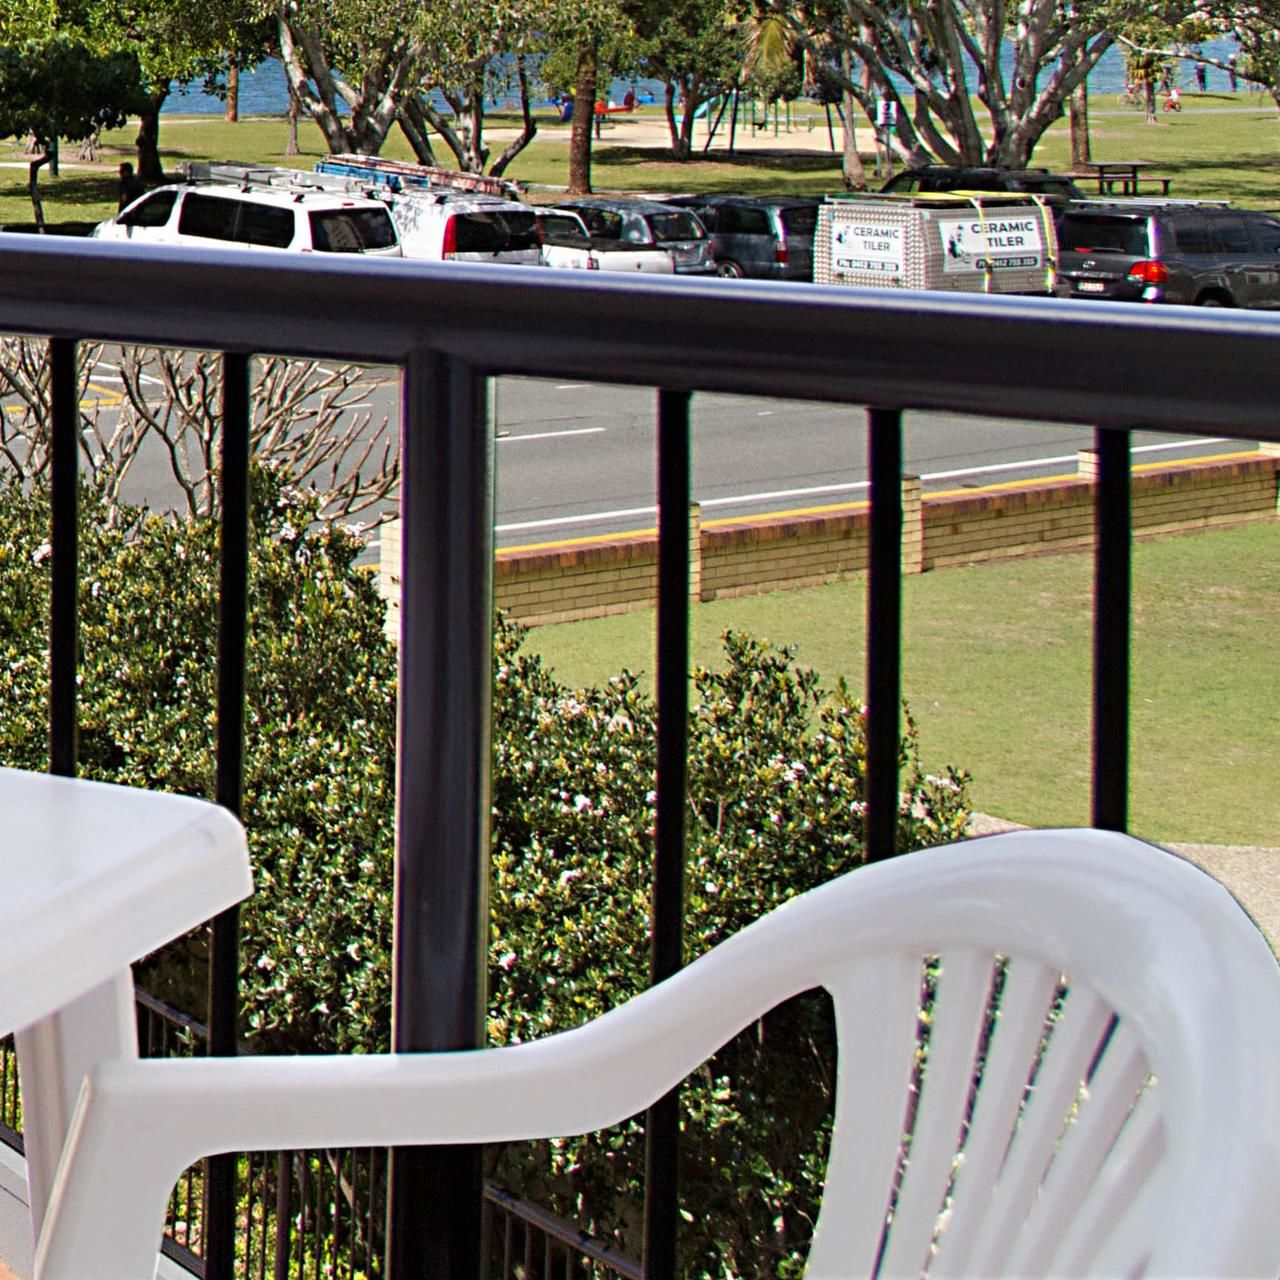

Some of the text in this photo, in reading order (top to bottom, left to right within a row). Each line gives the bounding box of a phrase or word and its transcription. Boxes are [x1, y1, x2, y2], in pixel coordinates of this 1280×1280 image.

[853, 226, 900, 239] CERAMIC
[971, 221, 1034, 234] CERAMIC
[863, 240, 891, 251] TILER
[986, 236, 1024, 248] TILER
